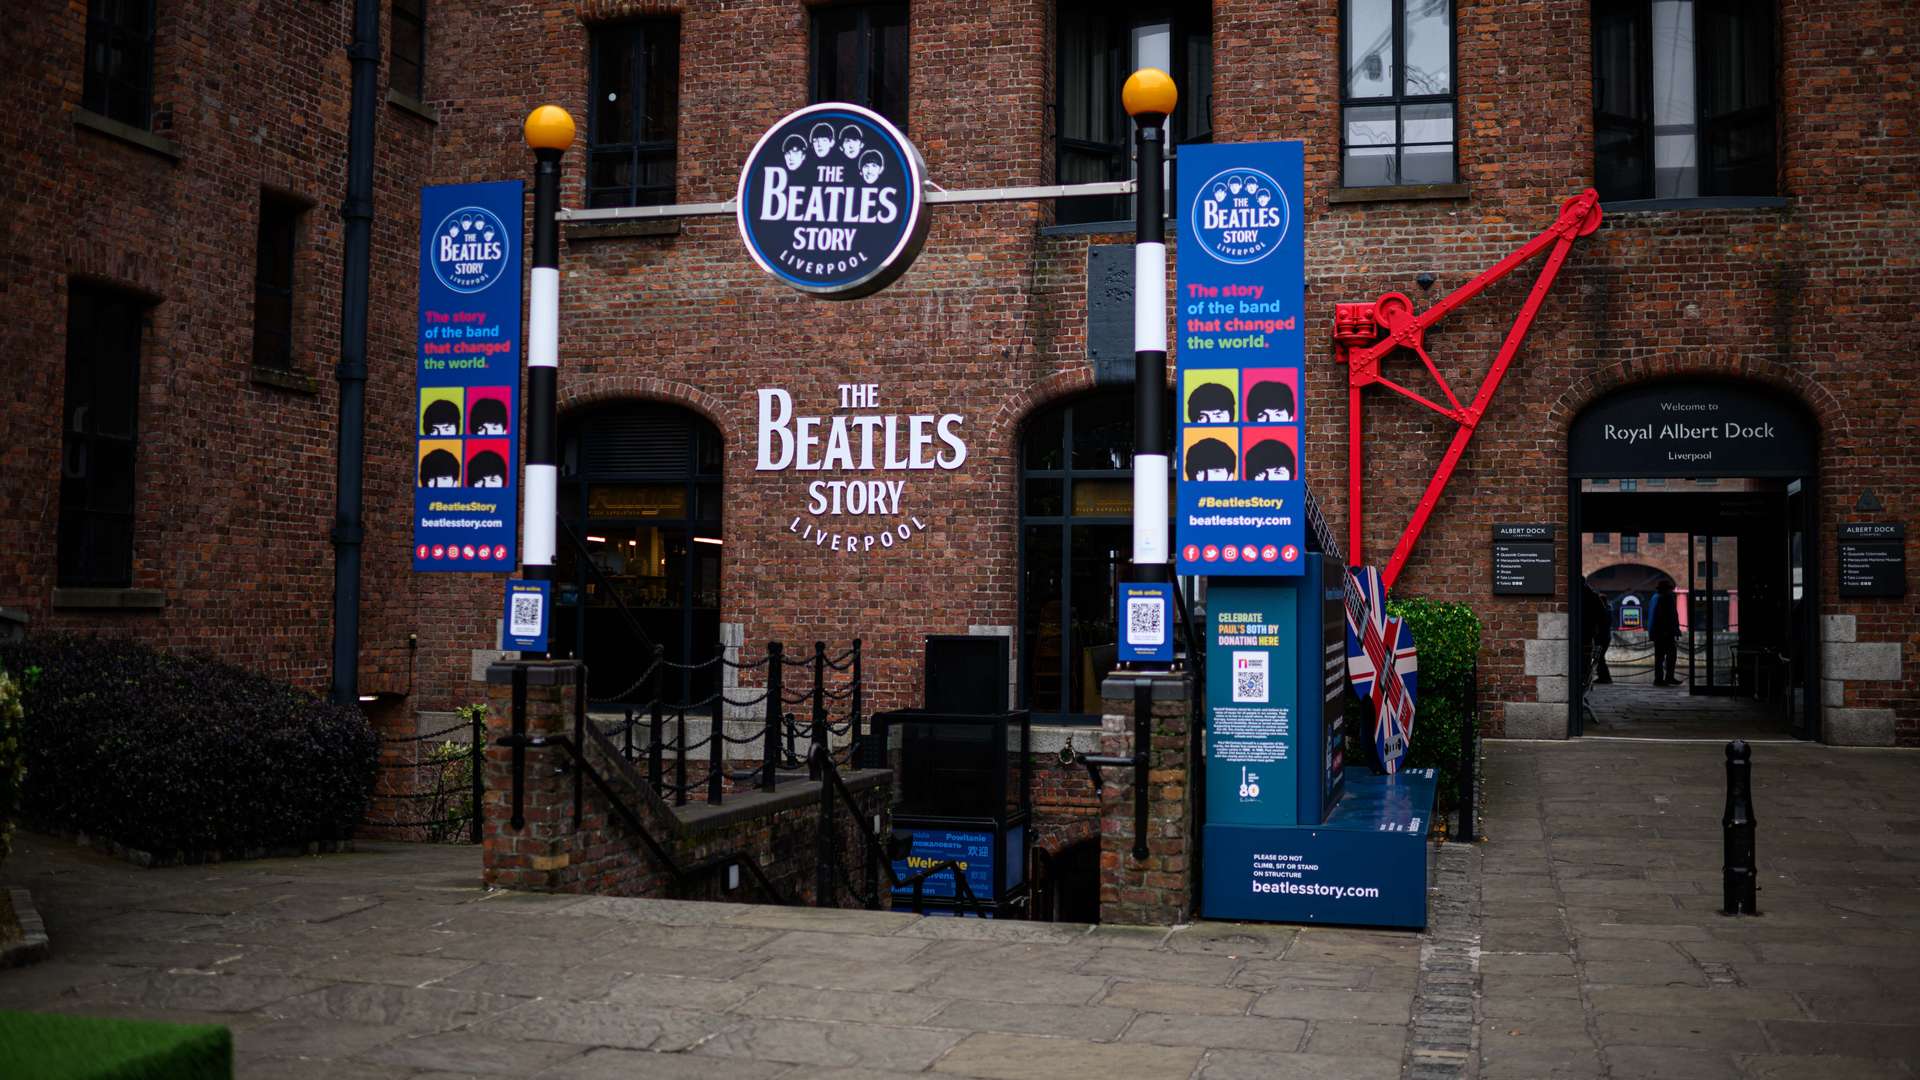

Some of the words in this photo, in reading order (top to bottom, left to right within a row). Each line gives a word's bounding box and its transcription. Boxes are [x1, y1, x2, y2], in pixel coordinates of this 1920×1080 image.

[817, 166, 844, 182] THE
[760, 166, 898, 224] BEATLES
[1233, 198, 1248, 208] THE
[1204, 200, 1280, 229] BEATLES
[464, 234, 477, 242] THE
[792, 226, 856, 250] STORY
[1223, 230, 1258, 244] STORY
[440, 235, 501, 262] BEATLES
[1216, 242, 1266, 256] LIVERPOOL
[455, 263, 484, 275] STORY
[780, 250, 868, 274] LIVERPOOL
[450, 274, 490, 286] LIVERPOOL
[1188, 284, 1218, 298] The
[1222, 285, 1264, 298] story
[1188, 302, 1204, 314] of
[1208, 302, 1234, 314] the
[1240, 300, 1280, 313] band
[425, 311, 449, 323] The
[453, 311, 487, 325] story
[1188, 318, 1220, 332] that
[1224, 316, 1295, 332] changed
[425, 327, 439, 338] of
[442, 326, 462, 338] the
[466, 325, 499, 338] band
[424, 342, 450, 354] that
[454, 340, 510, 356] changed
[1187, 336, 1214, 349] the
[1218, 334, 1269, 348] world.
[424, 358, 445, 369] the
[448, 356, 489, 368] world.
[838, 384, 880, 408] THE
[1660, 402, 1706, 411] Welcome
[1708, 402, 1718, 411] to
[755, 388, 966, 471] BEATLES
[1604, 424, 1652, 444] Royal
[1660, 424, 1718, 439] Albert
[1725, 422, 1774, 438] Dock
[1668, 451, 1712, 462] Liverpool
[808, 480, 906, 515] STORY
[1198, 496, 1283, 510] #BeatlesStory
[429, 502, 496, 513] #BeatlesStory
[422, 518, 502, 529] beatlesstory.com
[1190, 515, 1291, 528] beatlesstory.com
[790, 516, 926, 552] LIVERPOOL
[1218, 613, 1263, 622] CELEBRATE
[1218, 624, 1245, 634] PAUL'S
[1268, 624, 1279, 634] BY
[1218, 636, 1258, 646] DONATING
[1258, 636, 1280, 646] HERE
[1252, 880, 1379, 898] beatlesstory.com
